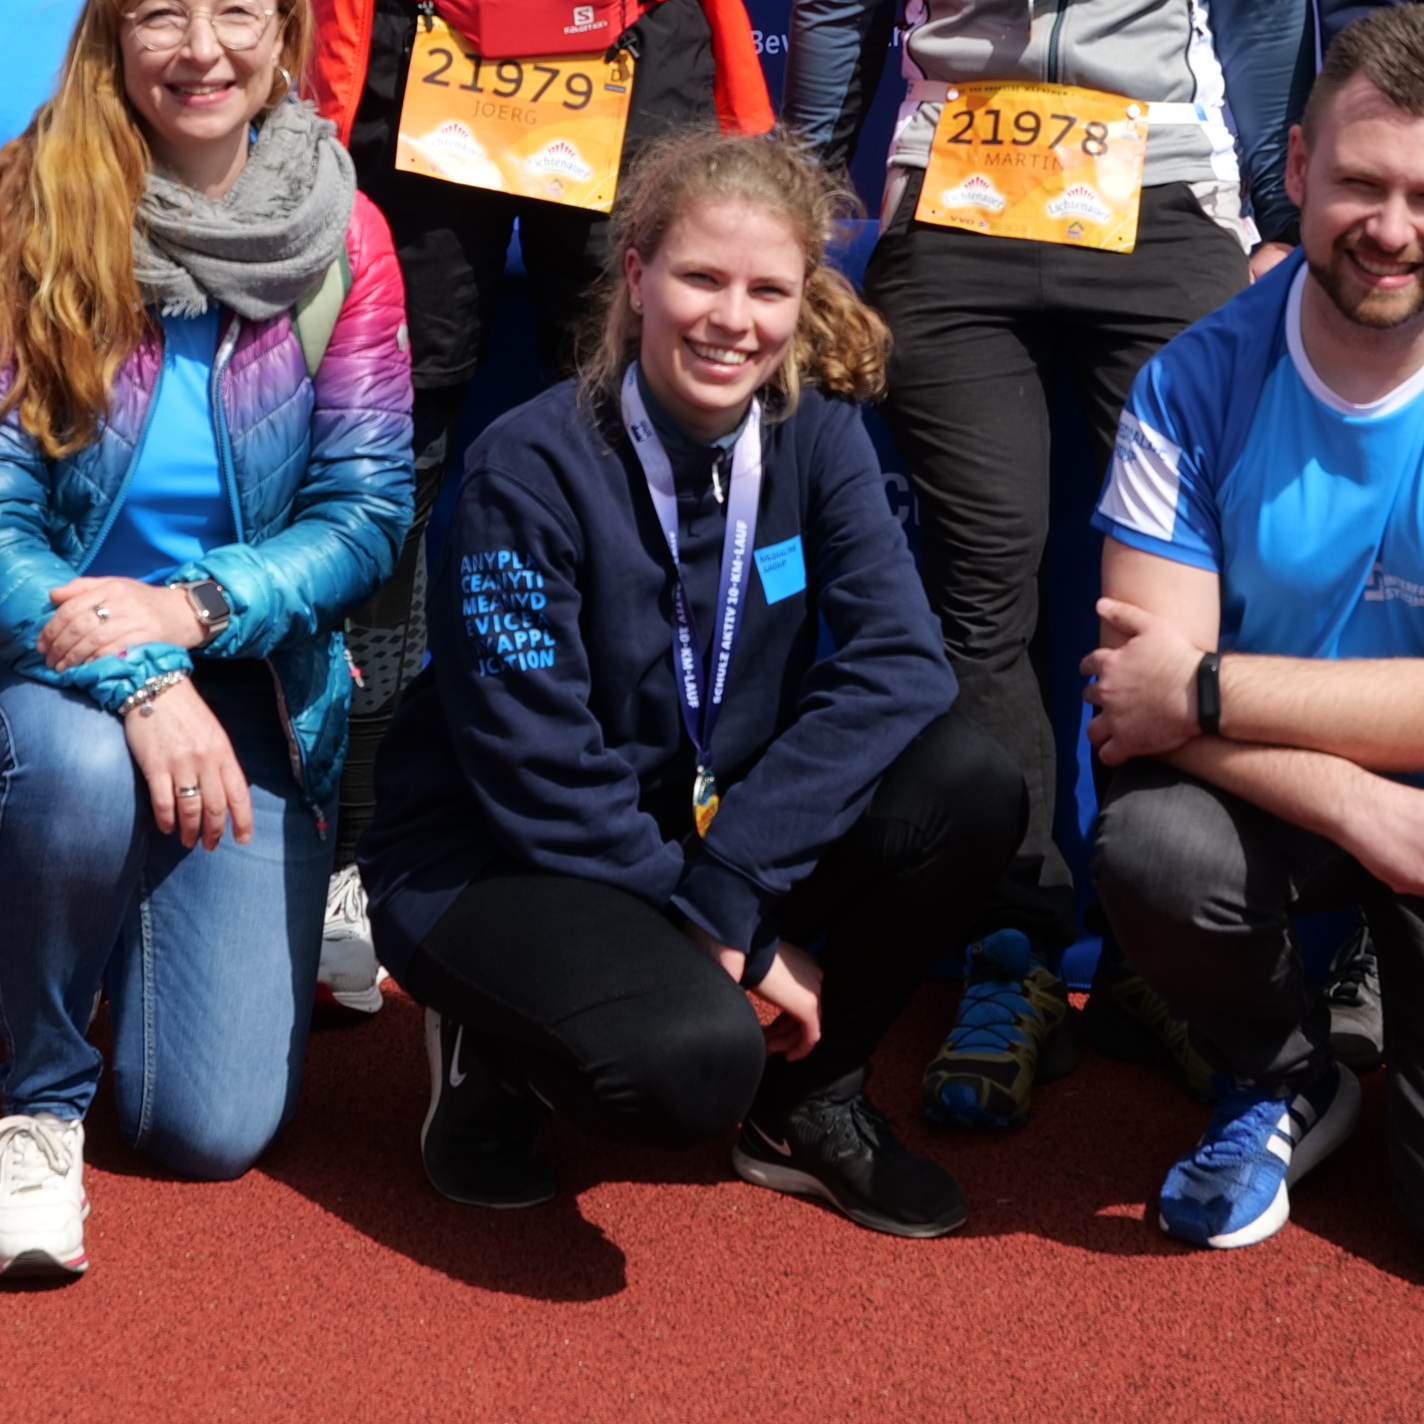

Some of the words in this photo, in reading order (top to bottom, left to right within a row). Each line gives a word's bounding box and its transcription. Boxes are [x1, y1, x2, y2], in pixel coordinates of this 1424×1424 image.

[421, 47, 594, 111] 21979
[471, 100, 538, 125] JOERG
[947, 108, 1109, 157] 21978
[984, 152, 1066, 172] MARTIN
[712, 651, 730, 705] SCHULZ
[721, 606, 737, 651] AKTIV
